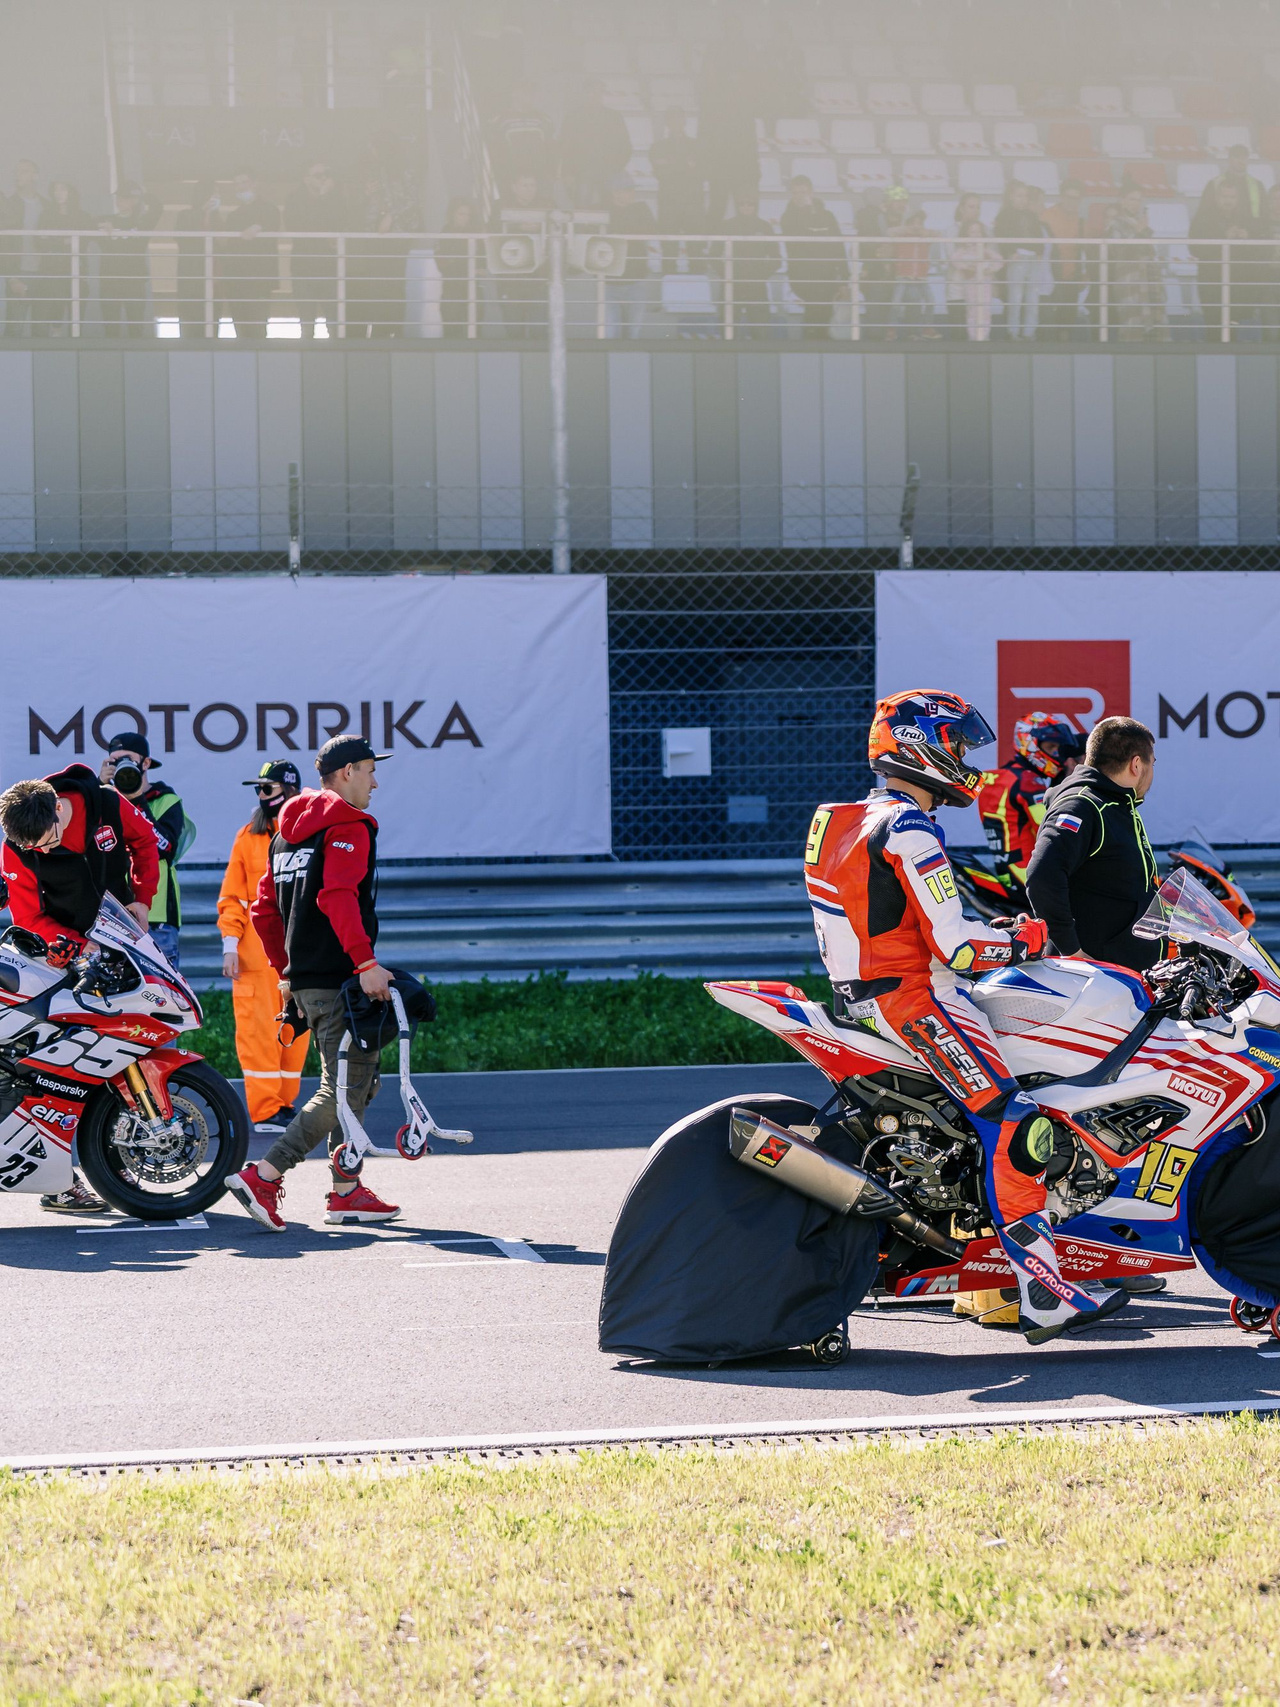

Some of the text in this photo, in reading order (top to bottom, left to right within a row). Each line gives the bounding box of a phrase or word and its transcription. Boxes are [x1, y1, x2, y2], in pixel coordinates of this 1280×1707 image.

[28, 699, 484, 755] MOTORRIKA
[896, 728, 921, 740] Arai
[965, 773, 978, 790] 19
[924, 868, 958, 904] 19
[981, 945, 1013, 959] SPB
[28, 1030, 151, 1078] 65
[804, 1035, 840, 1055] MOTUL
[35, 1074, 88, 1098] kaspersky
[1172, 1076, 1219, 1106] MOTUL
[30, 1103, 64, 1124] elf
[1133, 1139, 1201, 1208] 19
[1077, 1247, 1109, 1260] brembo
[1120, 1254, 1151, 1267] ÖHLINS
[962, 1261, 1014, 1275] MOTUL
[1023, 1256, 1076, 1300] daytona
